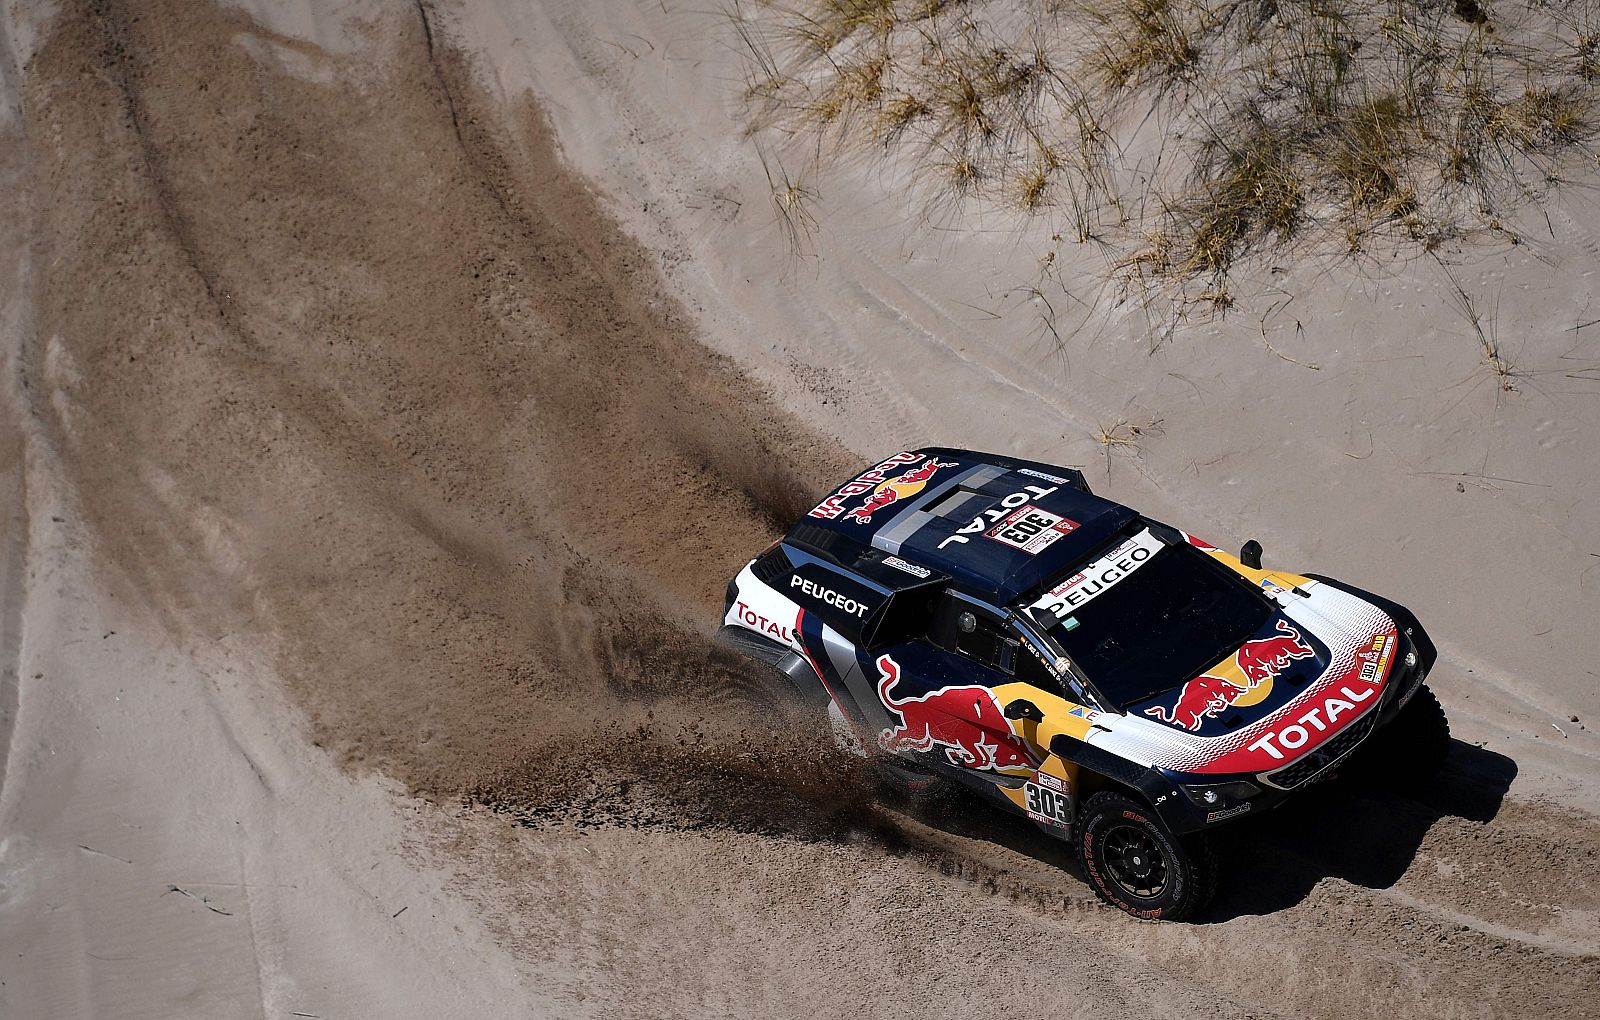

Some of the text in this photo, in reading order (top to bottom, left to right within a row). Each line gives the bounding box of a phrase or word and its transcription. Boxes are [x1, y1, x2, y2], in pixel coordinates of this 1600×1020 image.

[807, 452, 927, 520] Red Bull
[936, 485, 1059, 549] TOTAL
[1001, 513, 1054, 544] 303
[790, 574, 869, 618] PEUGEOT
[1053, 574, 1083, 594] MOTUL
[737, 601, 793, 643] TOTAL
[1371, 635, 1386, 652] 2018
[1361, 664, 1376, 680] 303
[1247, 685, 1375, 760] TOTAL
[1026, 783, 1072, 824] 303
